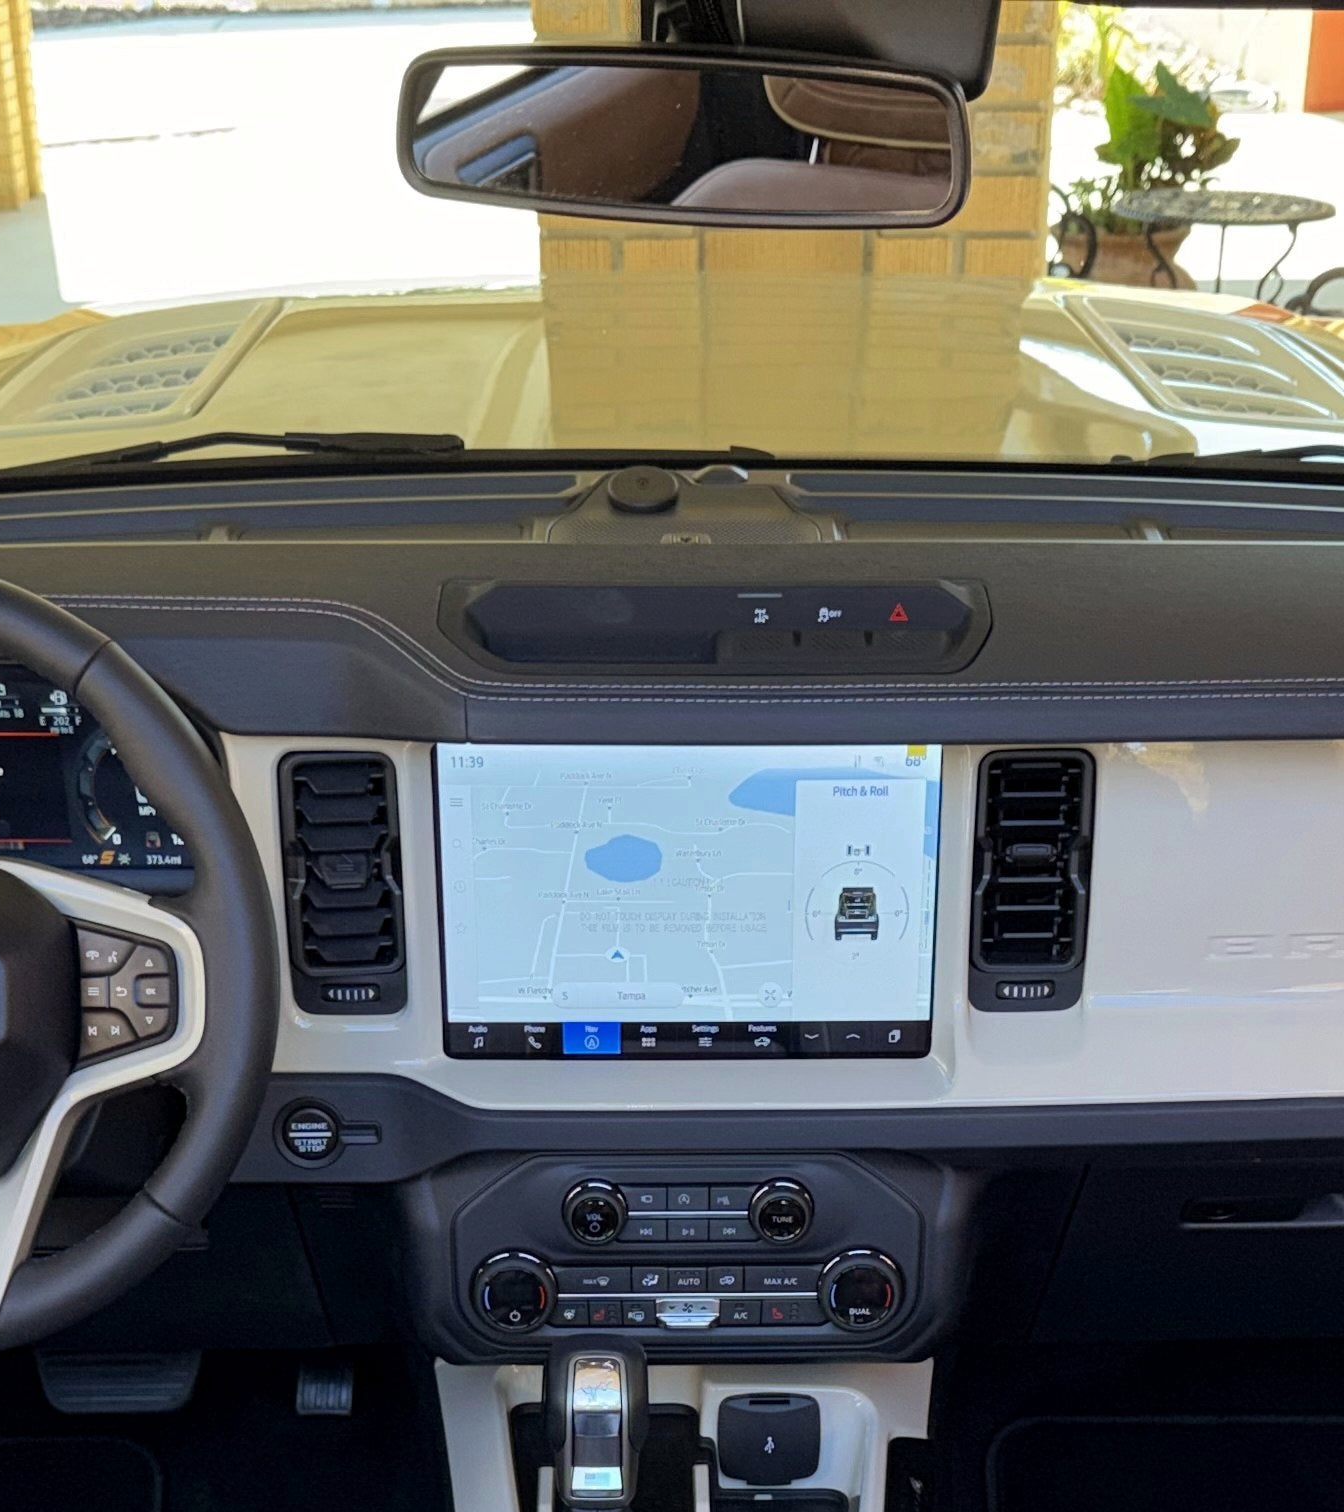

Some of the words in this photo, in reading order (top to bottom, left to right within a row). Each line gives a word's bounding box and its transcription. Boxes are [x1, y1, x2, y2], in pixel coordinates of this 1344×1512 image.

[450, 756, 484, 769] 11:39
[832, 785, 857, 797] Pitch
[859, 786, 867, 797] &
[870, 785, 889, 797] Roll
[617, 991, 646, 1001] Tampa
[468, 1025, 488, 1033] Audio
[524, 1025, 546, 1033] Phone
[585, 1025, 599, 1033] Nav
[640, 1025, 657, 1034] Apps
[691, 1024, 720, 1034] Settings
[748, 1024, 777, 1033] Features
[291, 1122, 328, 1131] ENGINE
[293, 1138, 328, 1146] START
[298, 1145, 326, 1153] STOP
[586, 1212, 603, 1221] VOL
[772, 1215, 793, 1224] TUNE
[677, 1277, 701, 1286] AUTO
[763, 1277, 782, 1286] MAX
[783, 1277, 798, 1286] A/C
[733, 1311, 749, 1320] A/C
[849, 1307, 871, 1316] DUAL
